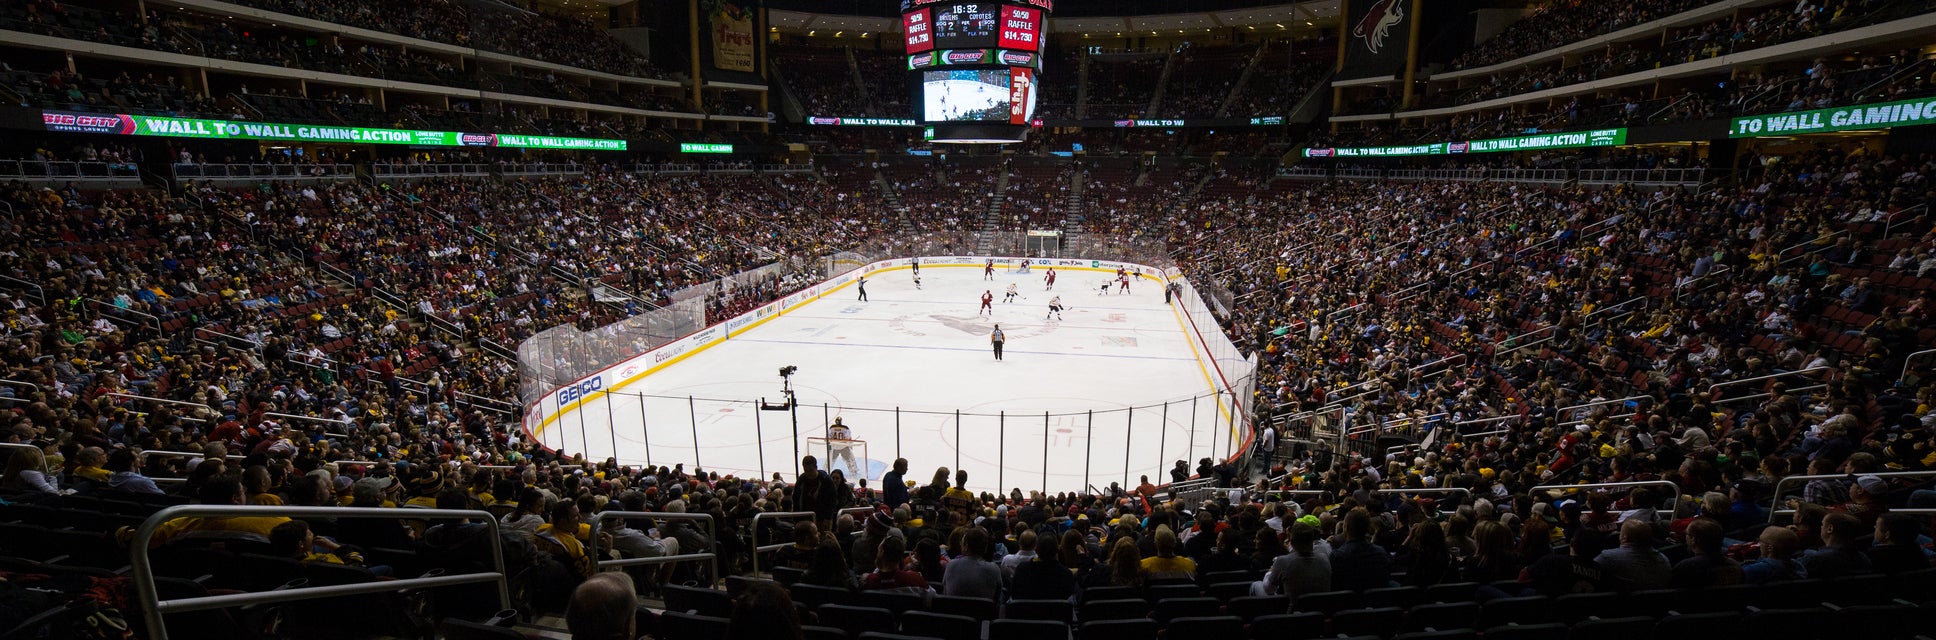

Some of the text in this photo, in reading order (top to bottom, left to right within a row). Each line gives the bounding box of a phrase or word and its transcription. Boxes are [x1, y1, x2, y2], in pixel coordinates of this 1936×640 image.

[953, 5, 977, 14] 16:32
[1013, 10, 1029, 19] 50/50
[910, 13, 923, 23] 50/50
[909, 23, 927, 34] RAFFLE
[948, 21, 953, 31] 2
[1008, 20, 1032, 30] RAFFLE
[43, 113, 121, 127] BIG CITY
[1738, 101, 1936, 134] TO WALL GAMING
[146, 118, 411, 142] WALL TO WALL GAMING ACTION
[502, 136, 528, 146] WALL
[529, 137, 540, 146] TO
[542, 137, 563, 147] WALL
[564, 139, 594, 148] GAMING
[594, 140, 619, 149] ACTION
[1471, 142, 1488, 151] WALL
[1488, 141, 1498, 150] TO
[1499, 140, 1517, 150] WALL
[1518, 136, 1550, 148] GAMING
[1551, 133, 1587, 146] ACTION
[681, 143, 691, 151] TO
[692, 144, 710, 152] WALL
[1386, 146, 1412, 155] GAMING
[1412, 146, 1429, 154] ACTION
[559, 375, 602, 406] GEICO
